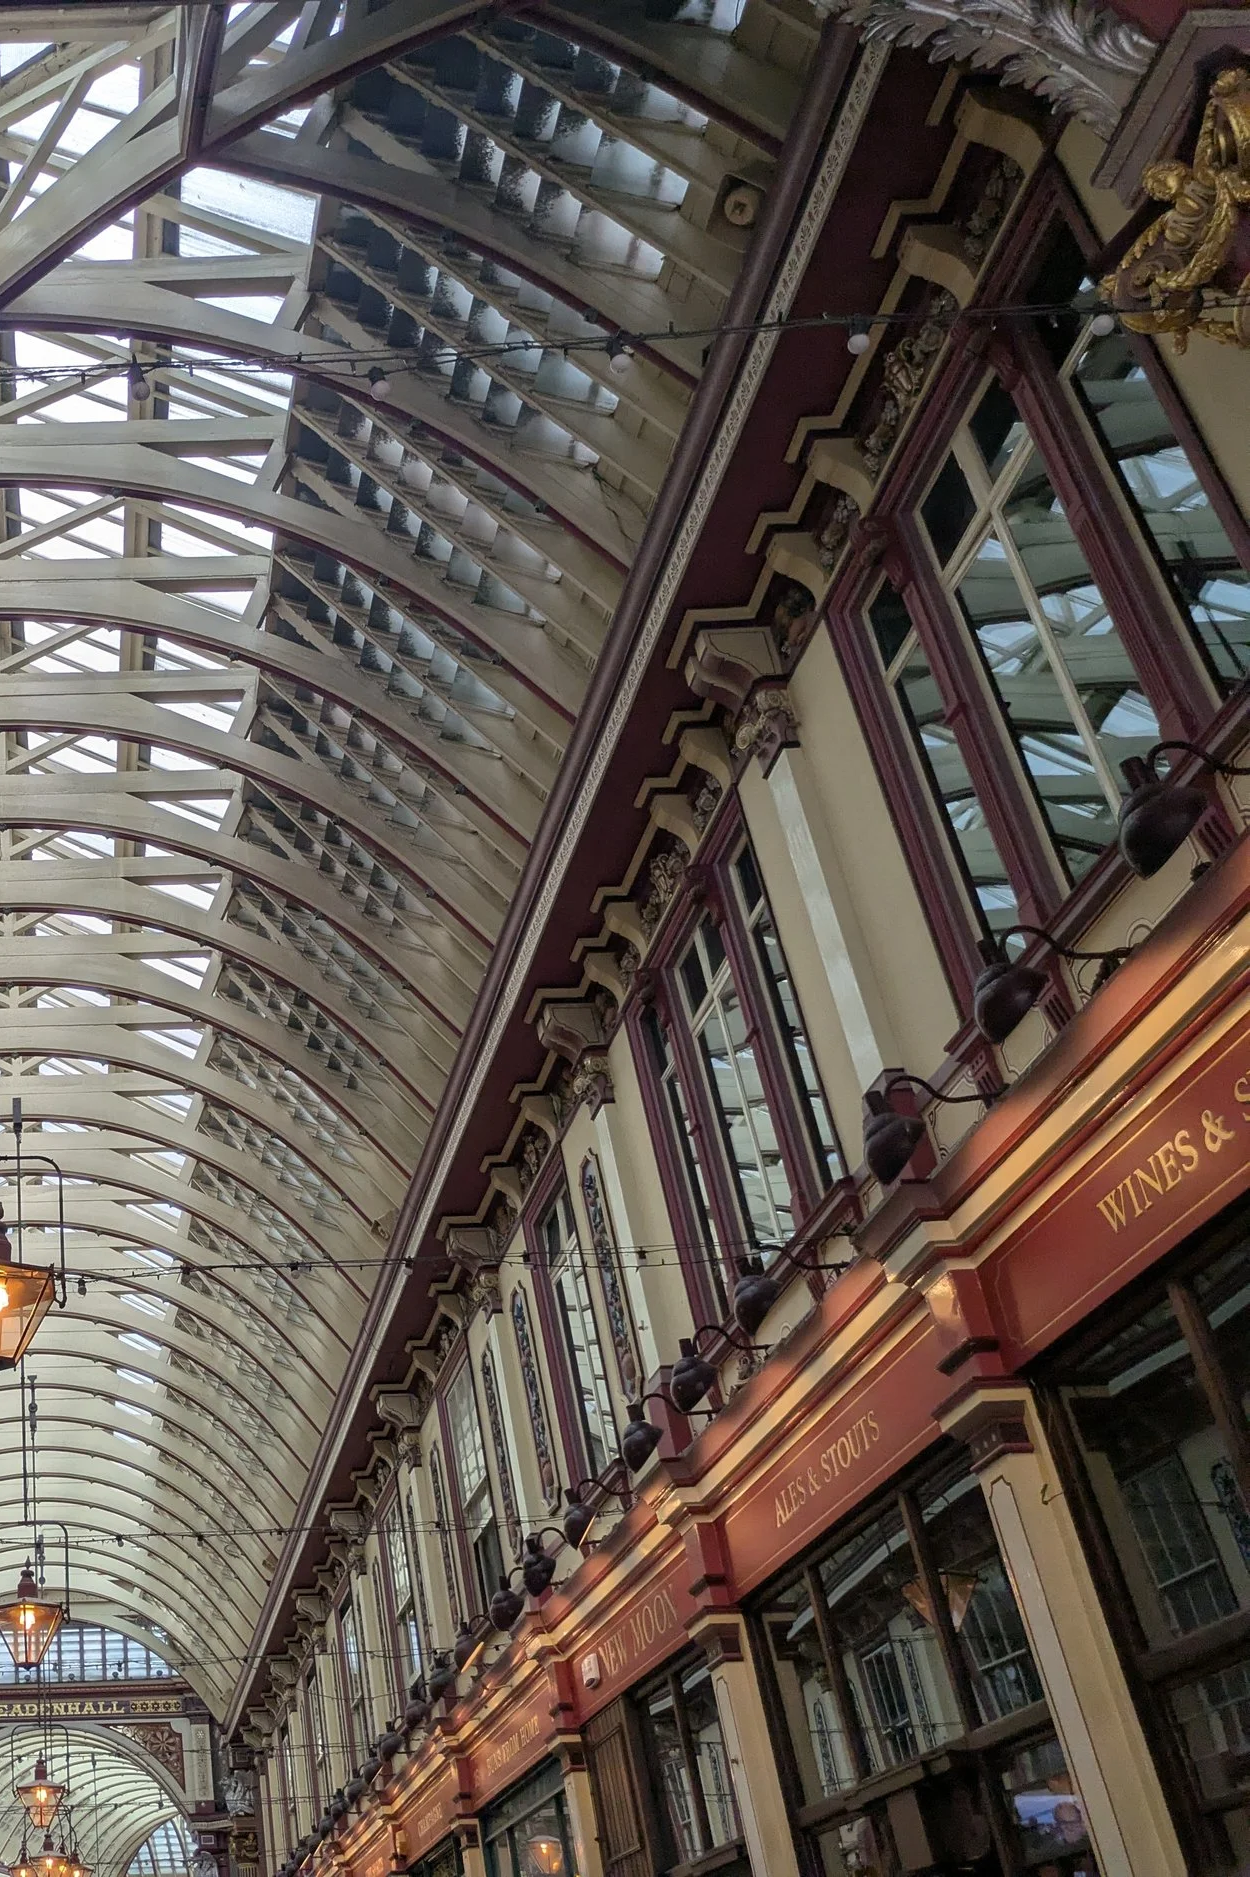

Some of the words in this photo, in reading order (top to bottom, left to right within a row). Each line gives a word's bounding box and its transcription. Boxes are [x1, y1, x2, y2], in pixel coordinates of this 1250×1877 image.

[1096, 1129, 1199, 1233] WINES
[1201, 1109, 1236, 1153] &
[775, 1476, 807, 1528] ALES
[807, 1466, 821, 1496] &
[820, 1410, 880, 1483] STOUTS
[598, 1627, 627, 1678] NEW
[629, 1583, 678, 1657] MOON
[519, 1714, 540, 1748] HOME
